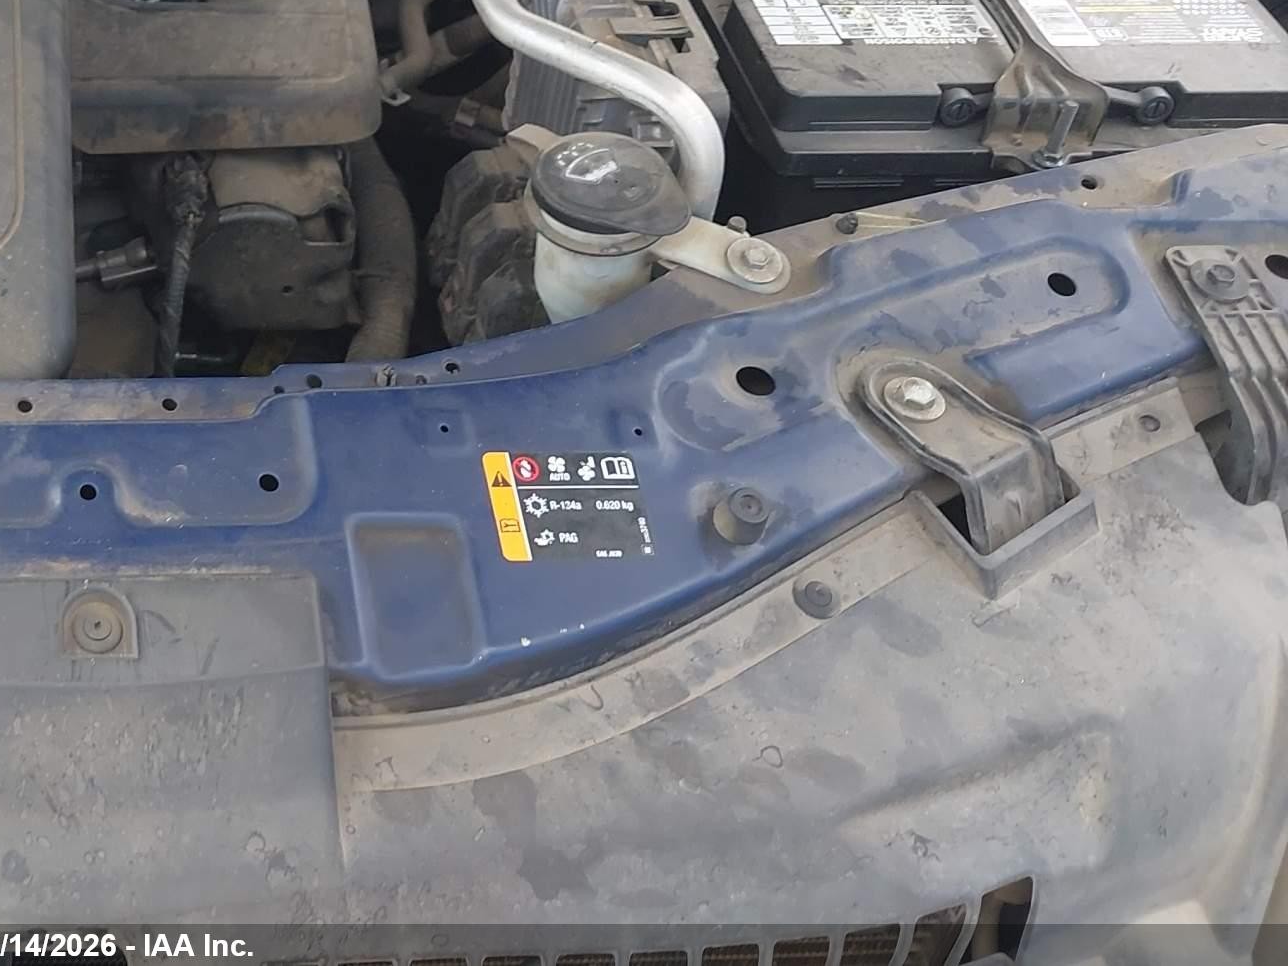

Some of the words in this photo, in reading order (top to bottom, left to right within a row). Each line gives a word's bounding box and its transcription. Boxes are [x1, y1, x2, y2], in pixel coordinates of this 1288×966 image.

[549, 472, 571, 481] AUTO
[621, 499, 634, 512] kg
[559, 533, 579, 543] PAG
